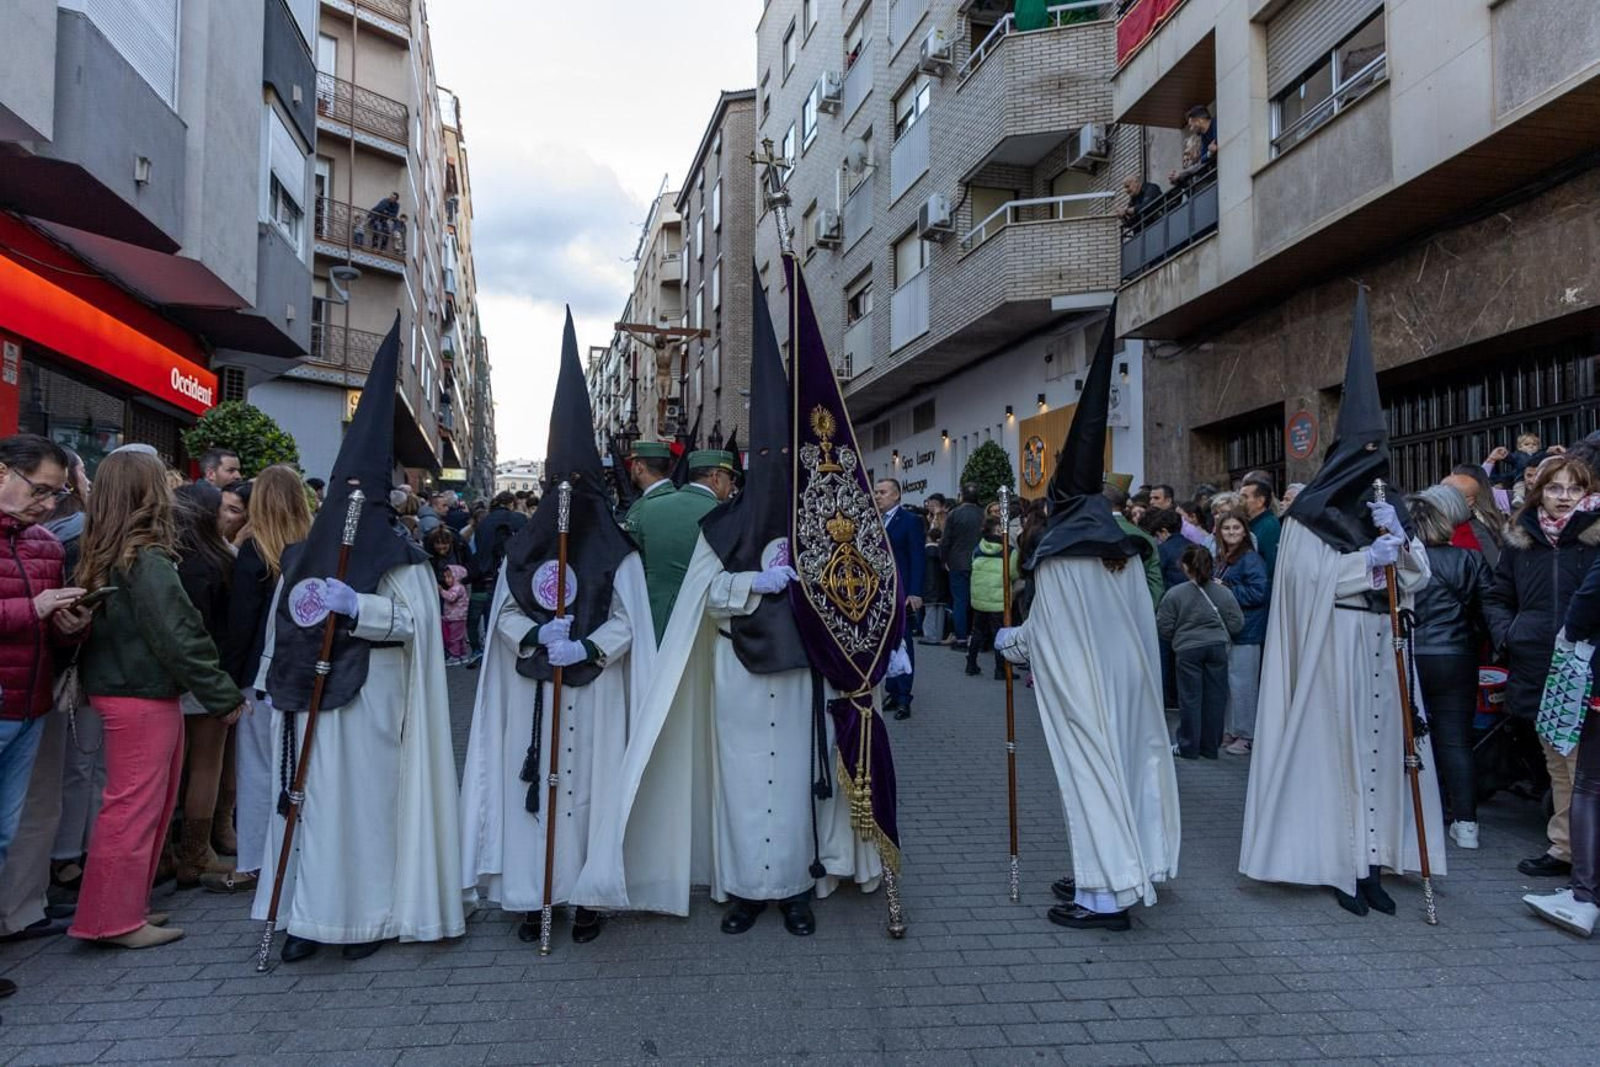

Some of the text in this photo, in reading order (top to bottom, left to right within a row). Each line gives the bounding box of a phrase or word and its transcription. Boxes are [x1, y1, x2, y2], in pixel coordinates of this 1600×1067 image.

[171, 367, 212, 407] Occident
[901, 450, 935, 473] Spa Luxury
[902, 479, 927, 494] Massage
